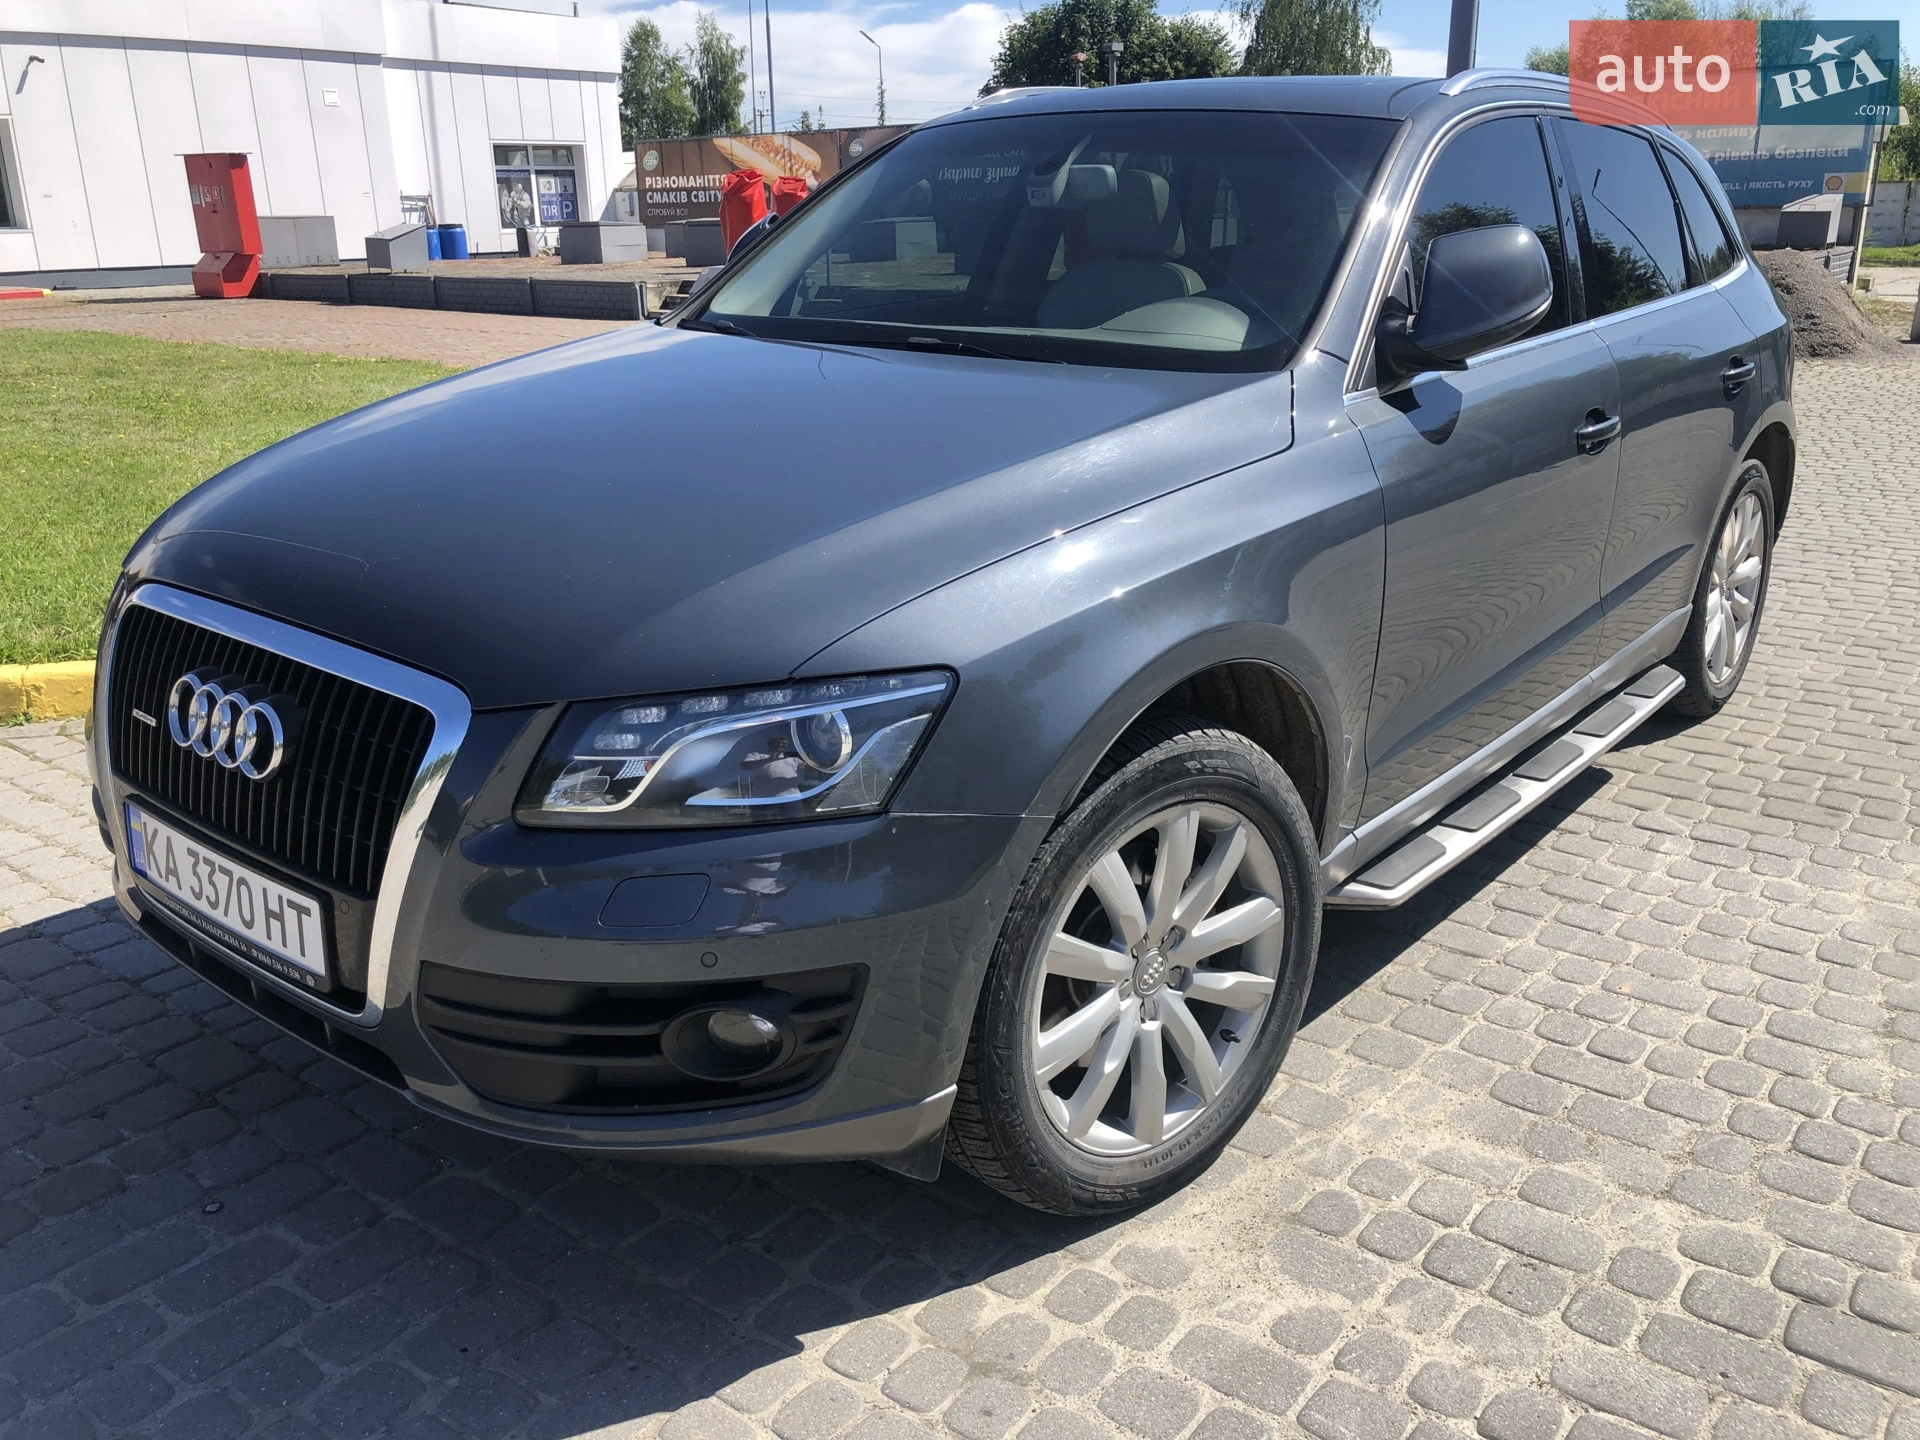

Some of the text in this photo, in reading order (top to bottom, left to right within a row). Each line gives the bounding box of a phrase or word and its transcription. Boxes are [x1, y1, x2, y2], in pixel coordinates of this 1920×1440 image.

[1714, 147, 1770, 165] рівень
[1775, 145, 1849, 159] безпеки
[1748, 180, 1785, 190] ЯКІСТЬ
[1787, 179, 1814, 188] РУХУ
[646, 190, 722, 204] СМАКІВ СВІТУ
[542, 205, 558, 217] TIR
[562, 201, 573, 219] P
[647, 207, 676, 216] СПРОБУЙ
[143, 821, 311, 957] KA 3370 HT
